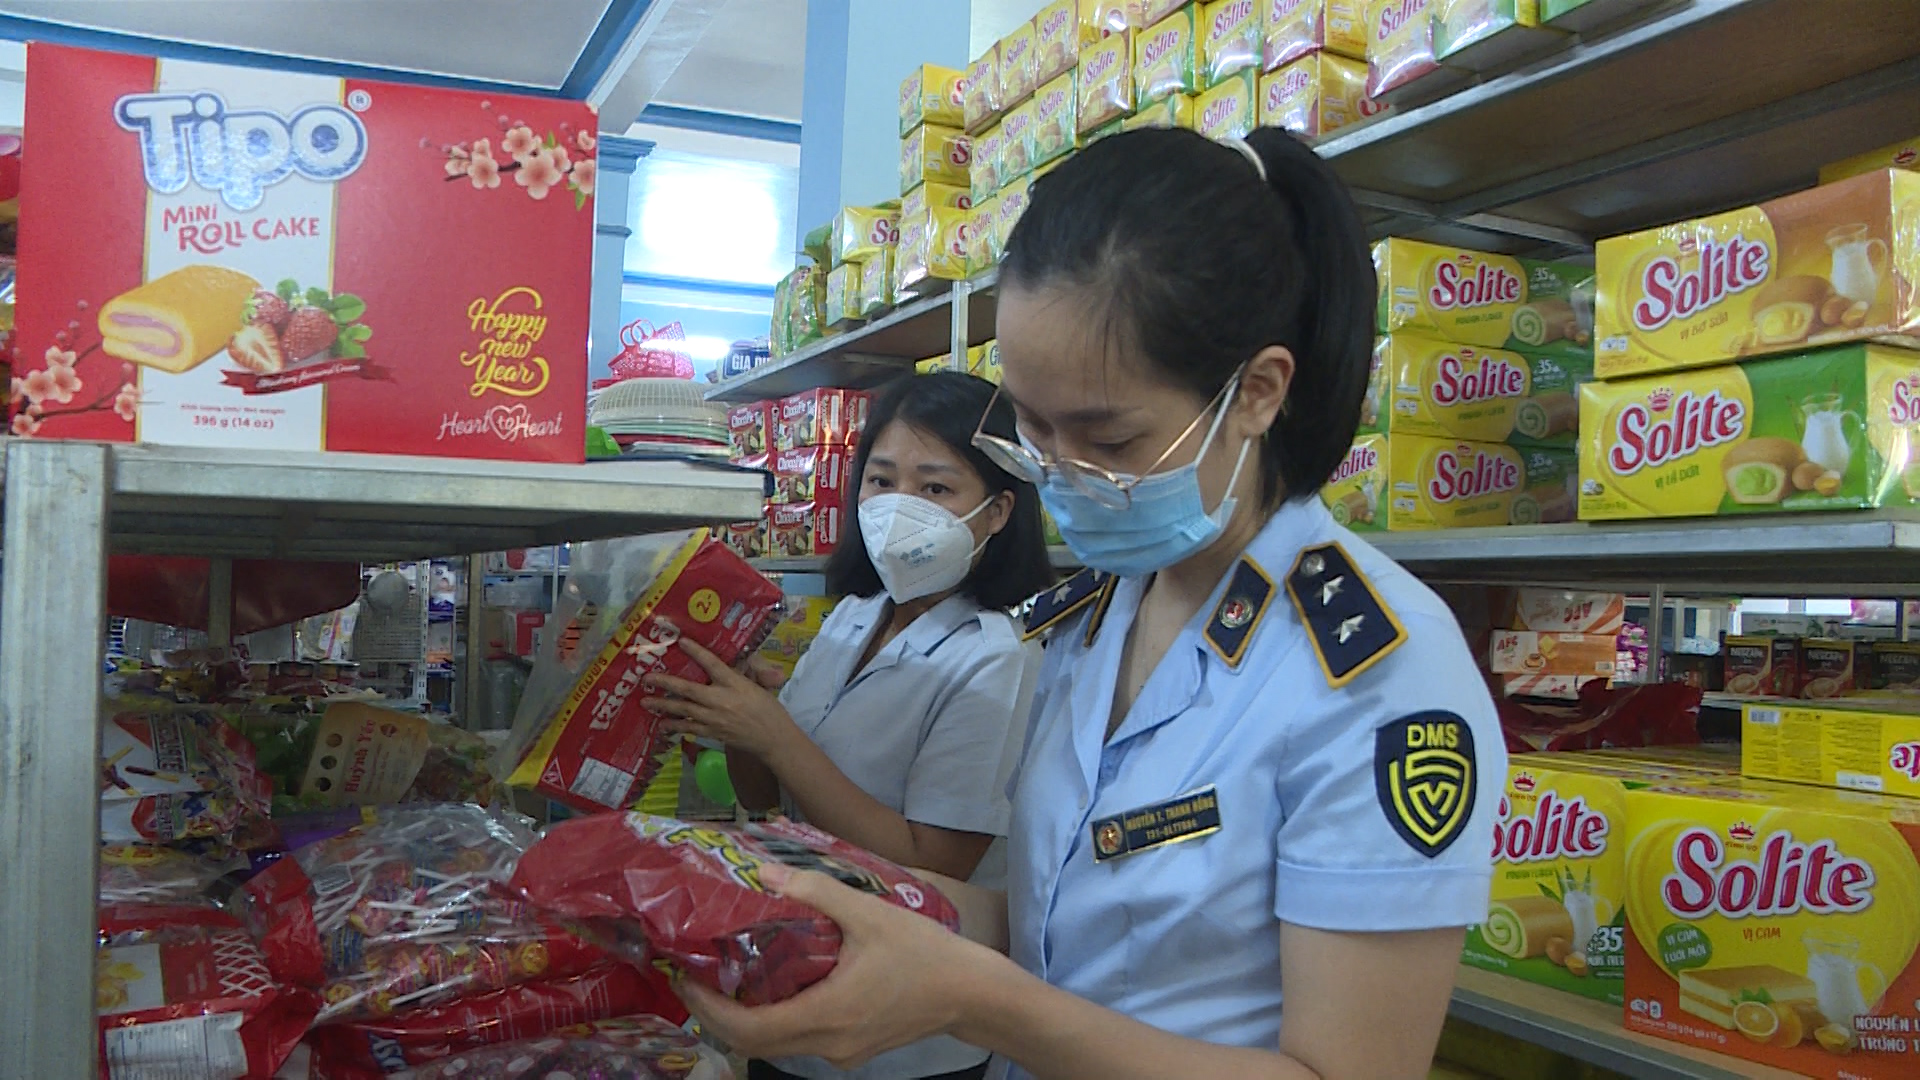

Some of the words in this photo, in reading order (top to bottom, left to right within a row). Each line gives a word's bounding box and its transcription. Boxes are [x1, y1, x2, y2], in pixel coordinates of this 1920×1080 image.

[1143, 31, 1178, 68] Solite
[115, 90, 367, 212] Tipo
[178, 221, 247, 253] ROLL
[253, 217, 320, 241] CAKE
[1432, 262, 1520, 308] Solite
[1635, 236, 1768, 328] Solite
[467, 286, 547, 341] Happy
[479, 338, 532, 358] new
[731, 354, 751, 371] GIA
[460, 351, 550, 397] Year
[1434, 358, 1522, 405] Solite
[193, 414, 216, 428] 396
[220, 419, 229, 428] g
[231, 417, 250, 428] (14
[436, 409, 491, 441] Heart
[510, 411, 563, 442] Heart
[1611, 392, 1743, 473] Solite
[1432, 453, 1519, 500] Solite
[1407, 723, 1458, 748] DMS
[1664, 833, 1868, 912] Solite
[1597, 926, 1624, 952] 35
[1756, 927, 1780, 940] CAM
